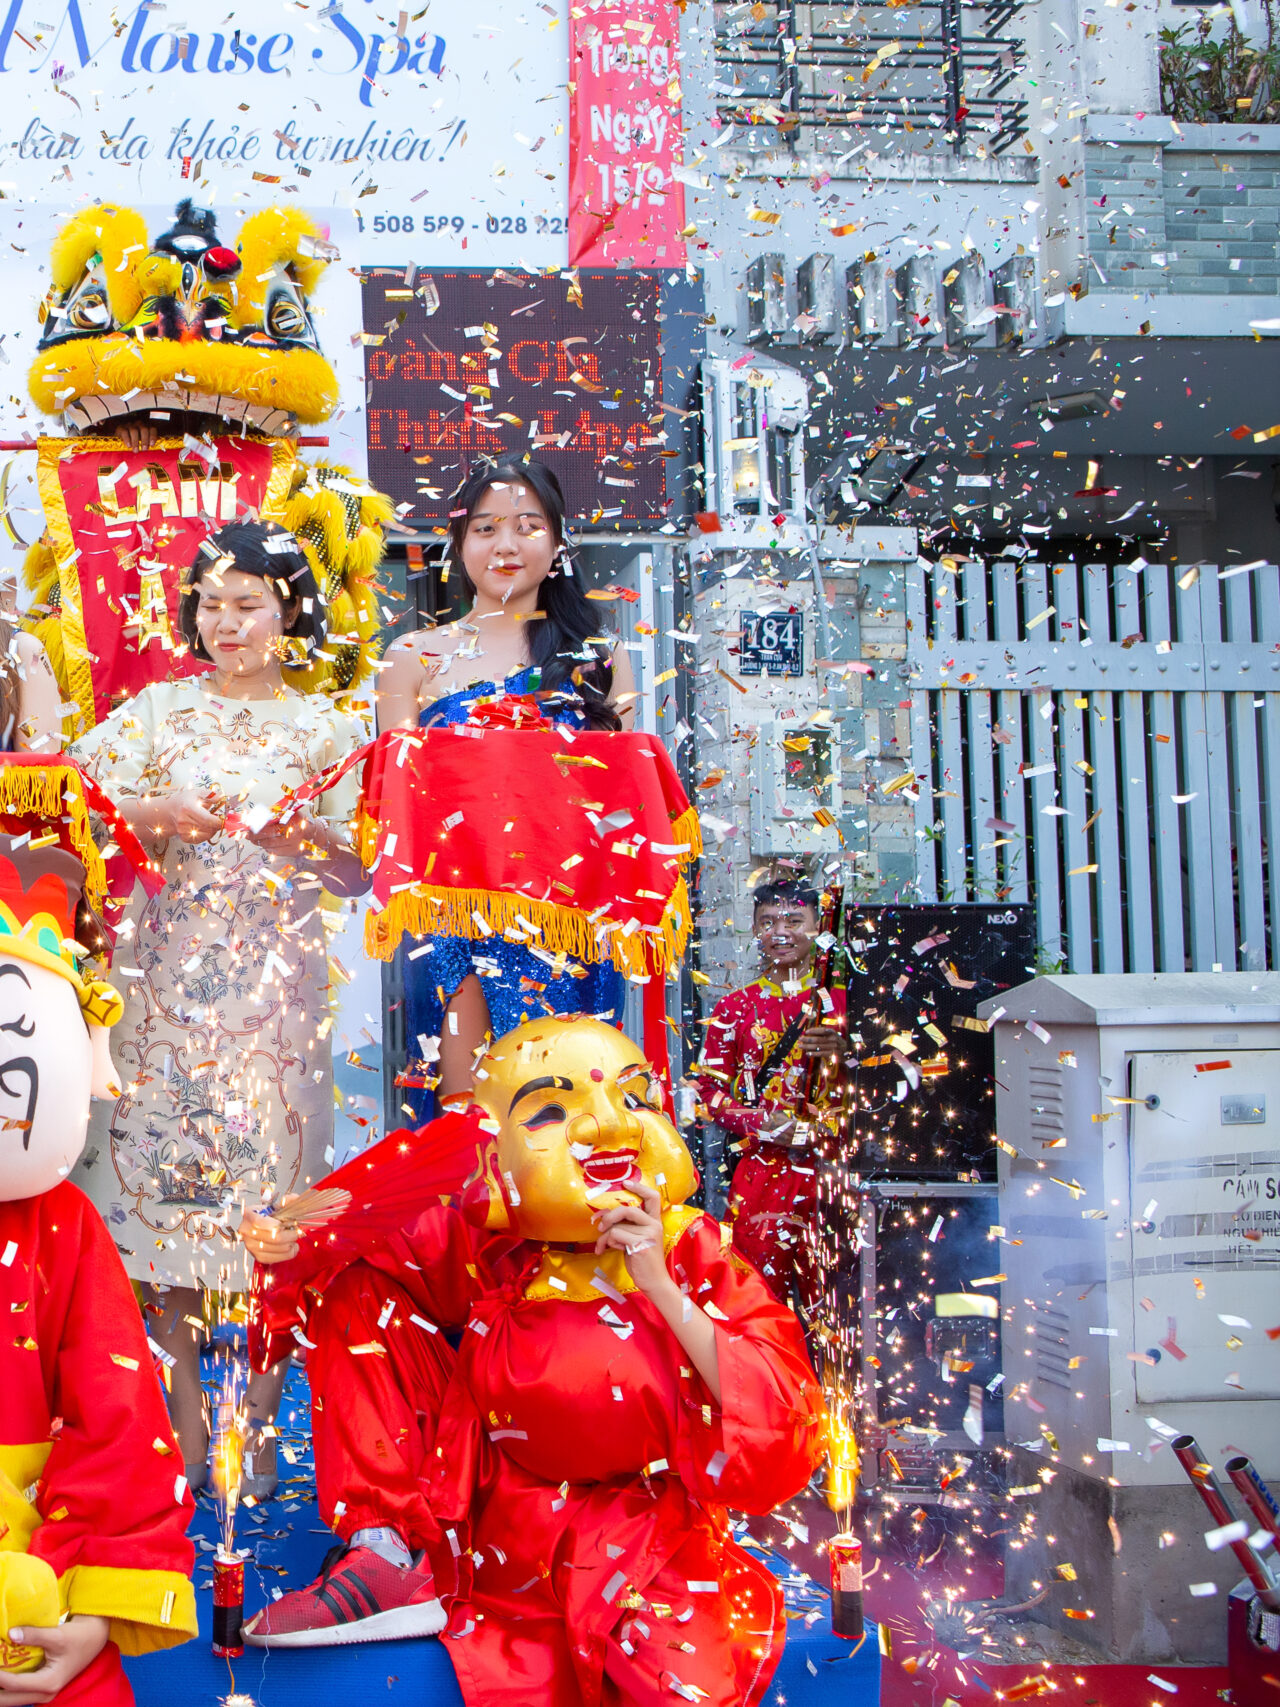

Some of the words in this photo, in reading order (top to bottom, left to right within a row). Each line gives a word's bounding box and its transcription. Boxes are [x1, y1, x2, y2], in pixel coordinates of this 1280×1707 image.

[29, 0, 295, 74] Mouse
[312, 0, 447, 107] Spa
[590, 42, 668, 86] Trong
[99, 117, 150, 161] da
[373, 216, 414, 233] 508
[423, 216, 465, 233] 589
[486, 217, 527, 234] 028
[508, 340, 602, 381] Gia
[747, 618, 796, 651] 184
[987, 914, 1018, 925] NEXO
[1265, 1177, 1280, 1199] S
